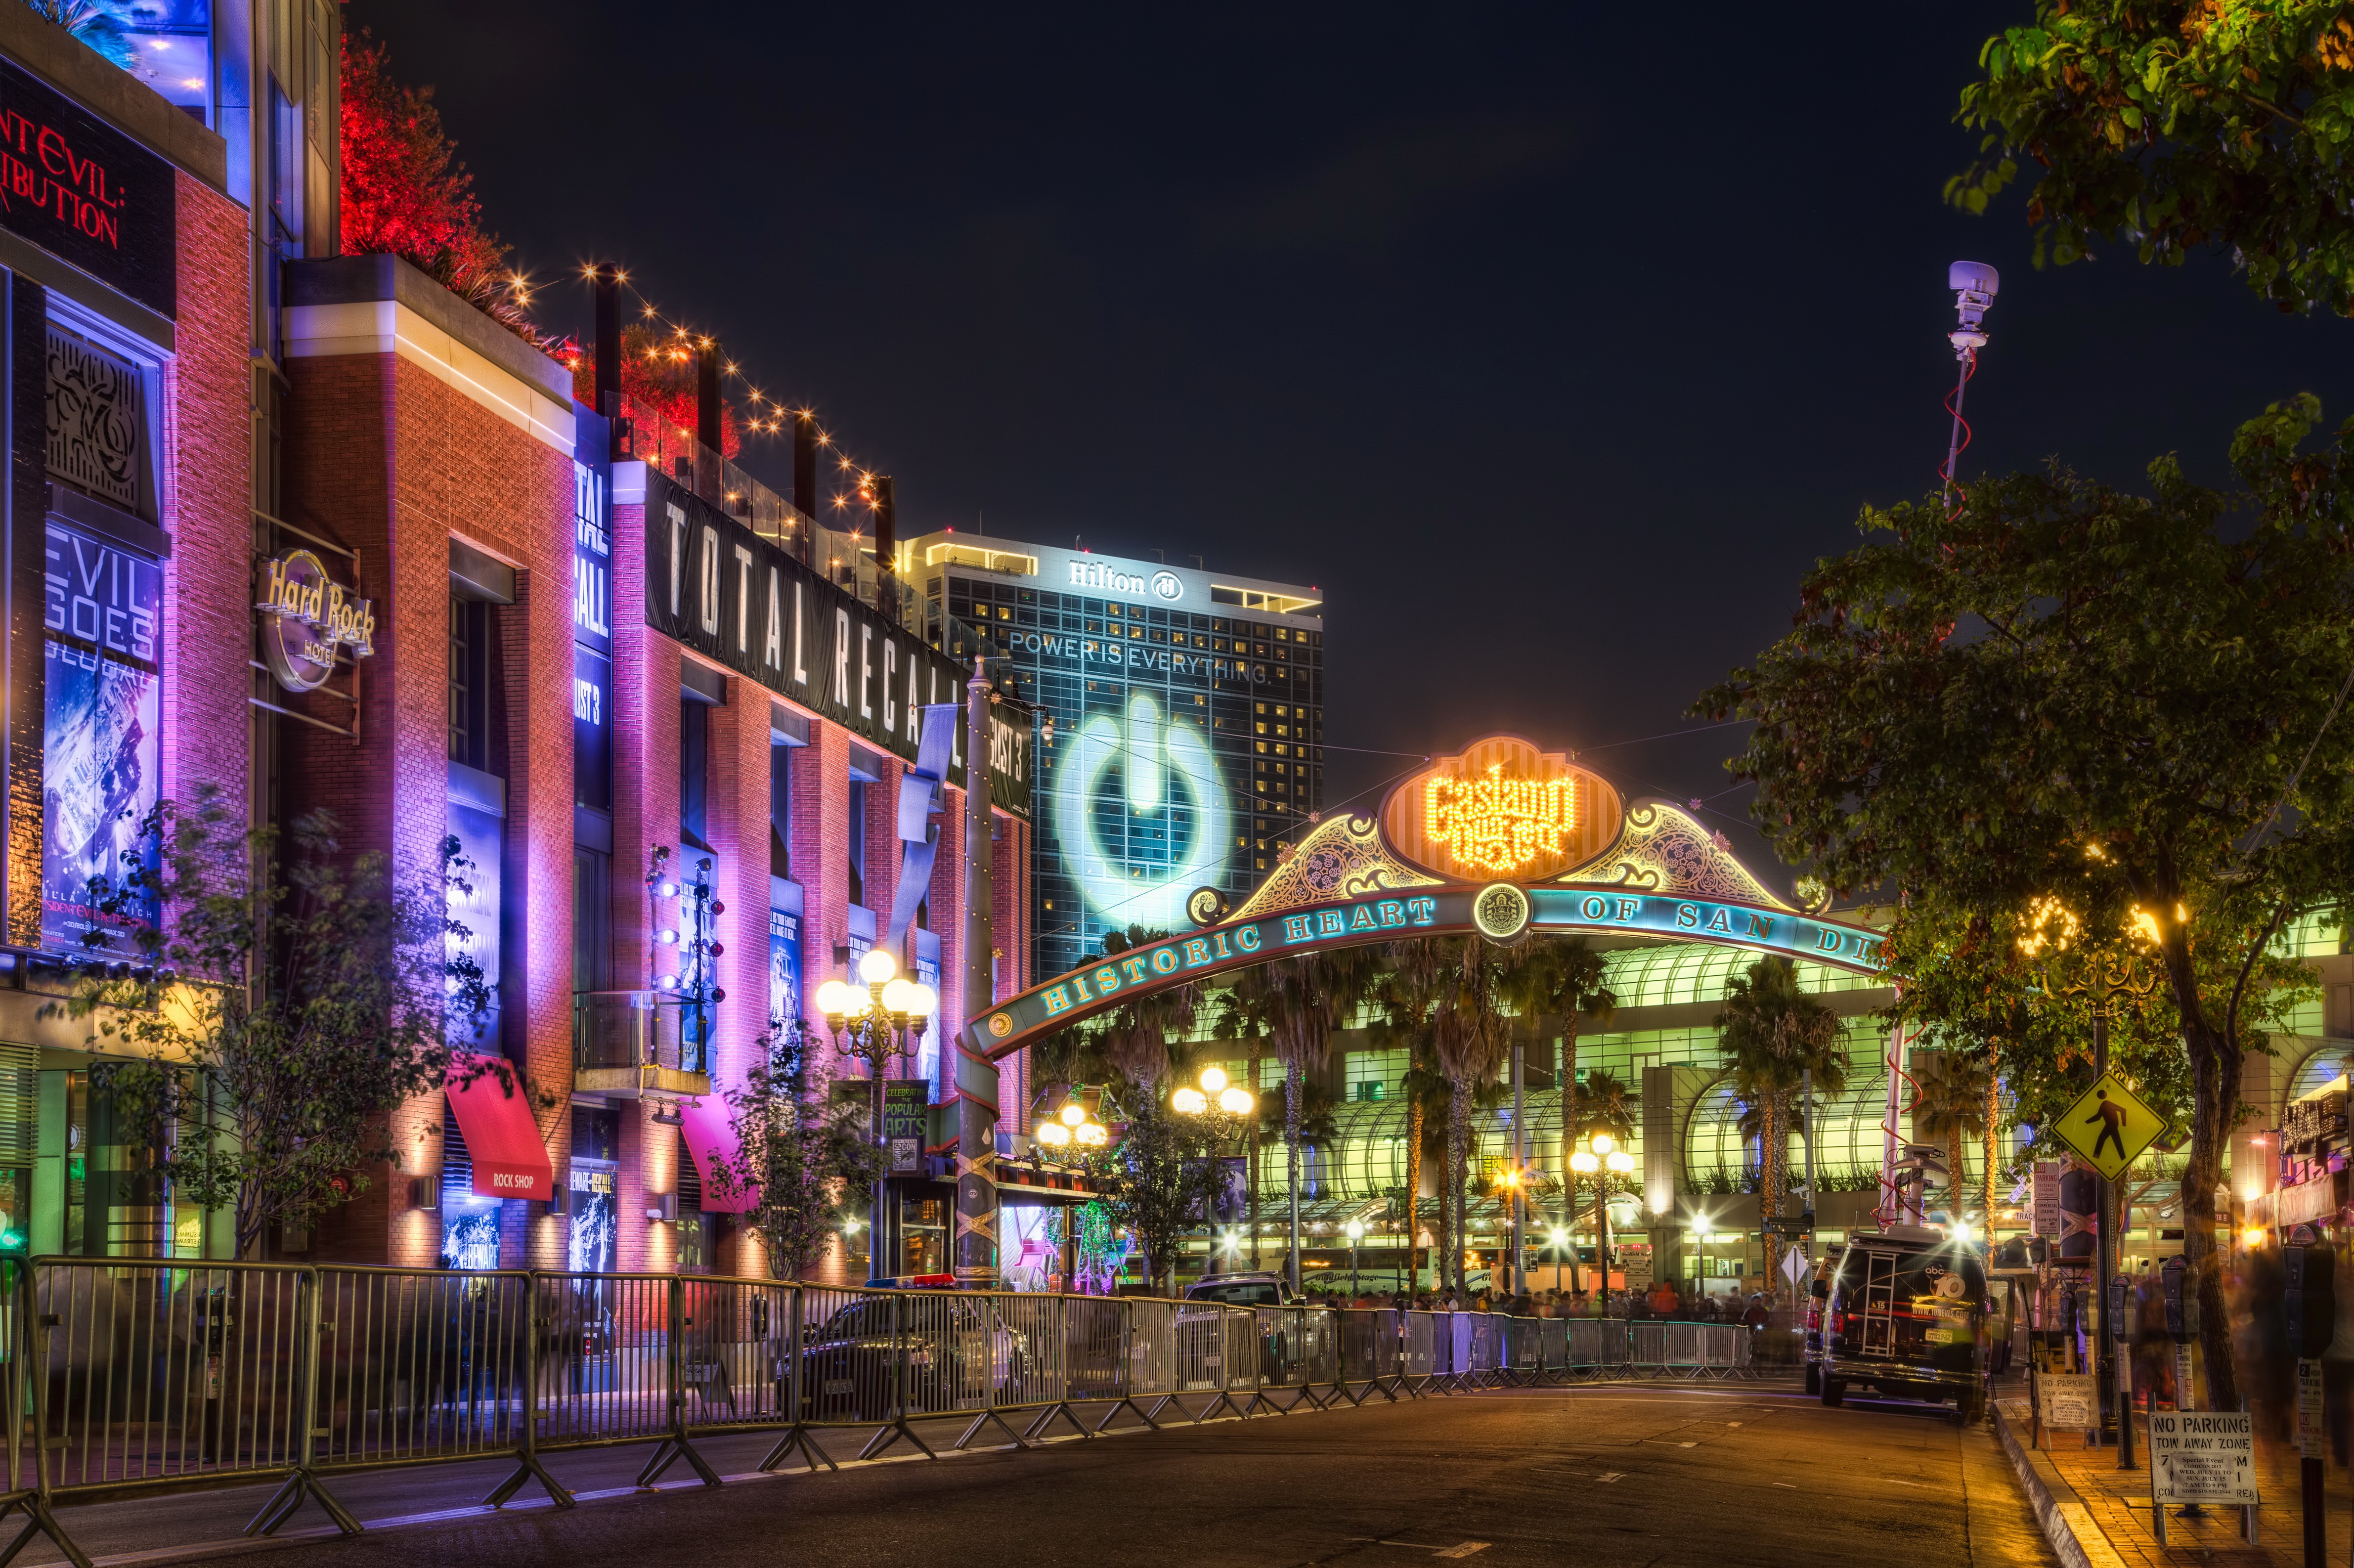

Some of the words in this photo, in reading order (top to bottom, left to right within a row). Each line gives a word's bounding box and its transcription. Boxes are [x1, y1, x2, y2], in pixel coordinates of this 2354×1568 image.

[0, 153, 118, 249] IBUTION
[45, 523, 154, 619] EVIL
[1069, 560, 1145, 594] Hilton
[270, 559, 324, 614] Hard
[328, 583, 375, 653] Rock
[574, 555, 608, 638] ALL
[666, 502, 806, 686] TOTAL
[45, 585, 154, 662] GOES
[305, 640, 336, 666] HOTEL
[1010, 632, 1094, 661] POWER
[1102, 643, 1122, 664] IS
[1128, 648, 1272, 686] EVERYTHING.
[593, 685, 600, 726] 3
[1015, 732, 1022, 782] 3
[44, 888, 76, 903] ILLA
[1040, 925, 1261, 1016] HISTORIC
[1284, 898, 1433, 943] HEART
[1582, 896, 1638, 921] OF
[1678, 904, 1775, 940] SAN
[886, 1088, 927, 1097] CELEBRATING
[885, 1103, 927, 1116] POPULAR
[884, 1117, 927, 1136] ARTS
[494, 1173, 513, 1188] ROCK
[515, 1174, 534, 1189] SHOP
[468, 1243, 498, 1269] BEWARE
[1357, 1273, 1379, 1282] Stage
[1925, 1266, 1945, 1275] abc
[1933, 1276, 1966, 1299] 10
[1912, 1307, 1969, 1320] WWW.10NEWS.COM
[2154, 1417, 2175, 1433] NO
[2183, 1417, 2249, 1434] PARKING
[2156, 1437, 2179, 1448] TOW
[2184, 1438, 2213, 1449] AWAY
[2218, 1438, 2250, 1449] ZONE
[2161, 1455, 2169, 1466] 7
